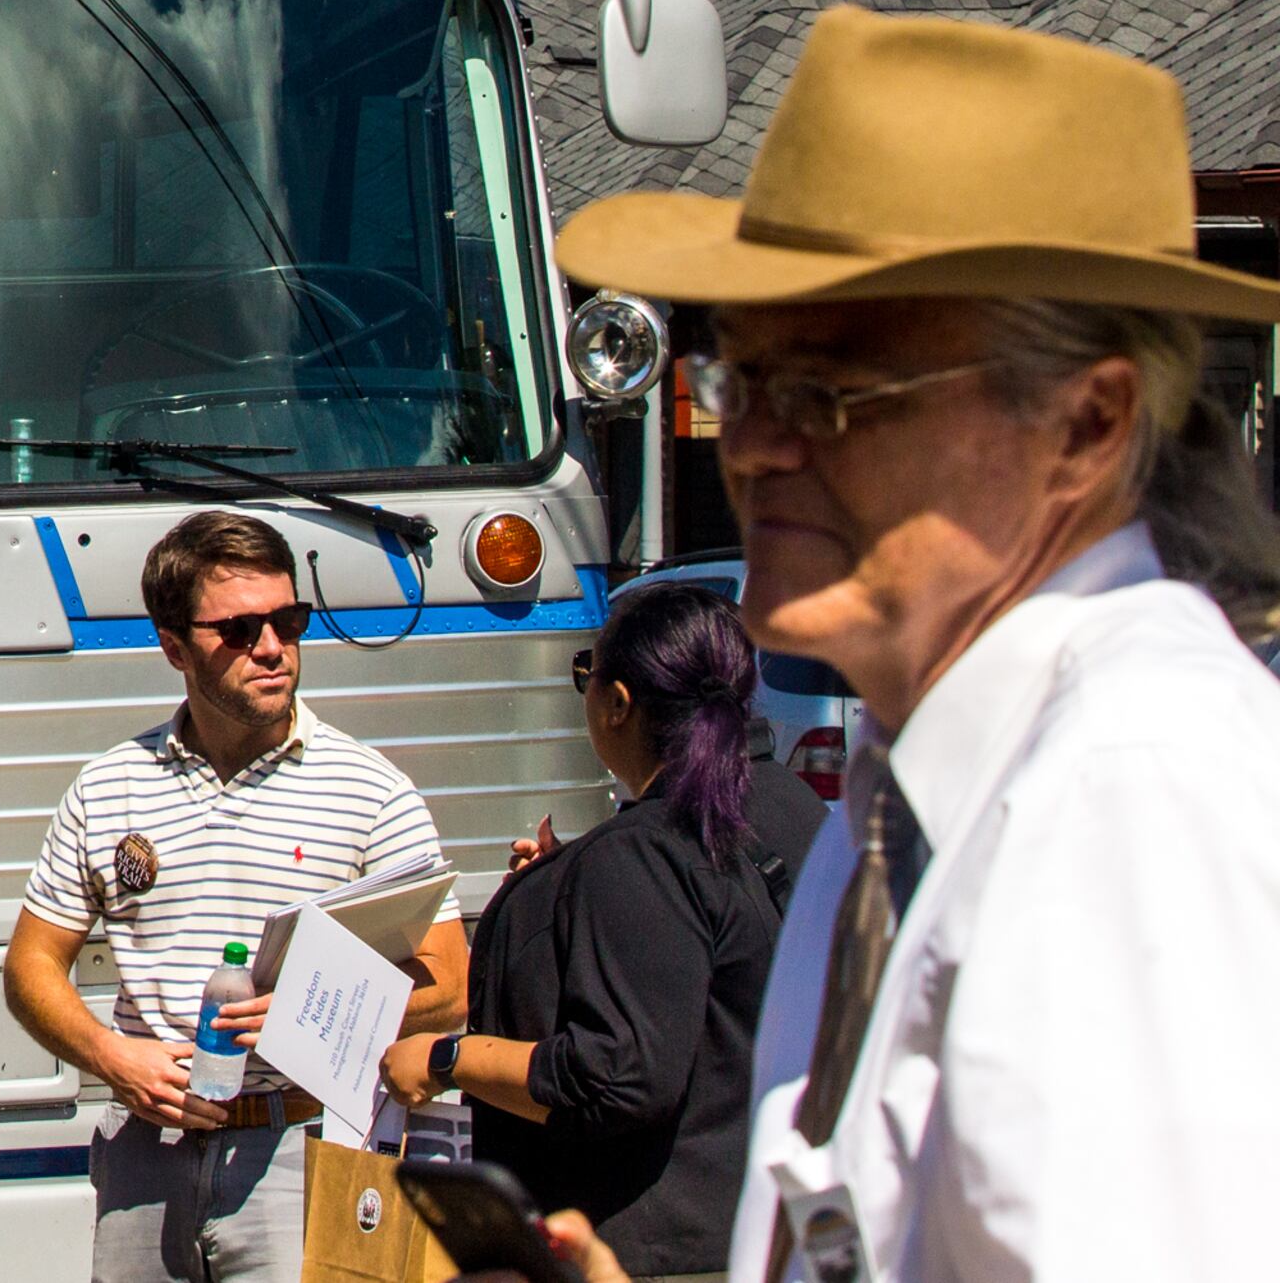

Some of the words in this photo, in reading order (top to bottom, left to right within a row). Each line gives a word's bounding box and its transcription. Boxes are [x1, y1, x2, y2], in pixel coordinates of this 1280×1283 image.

[116, 849, 151, 882] RIGHTS
[117, 861, 142, 889] TRAIL
[296, 970, 322, 1027] Freedom
[311, 989, 329, 1024] Rides
[319, 988, 343, 1042] Museum
